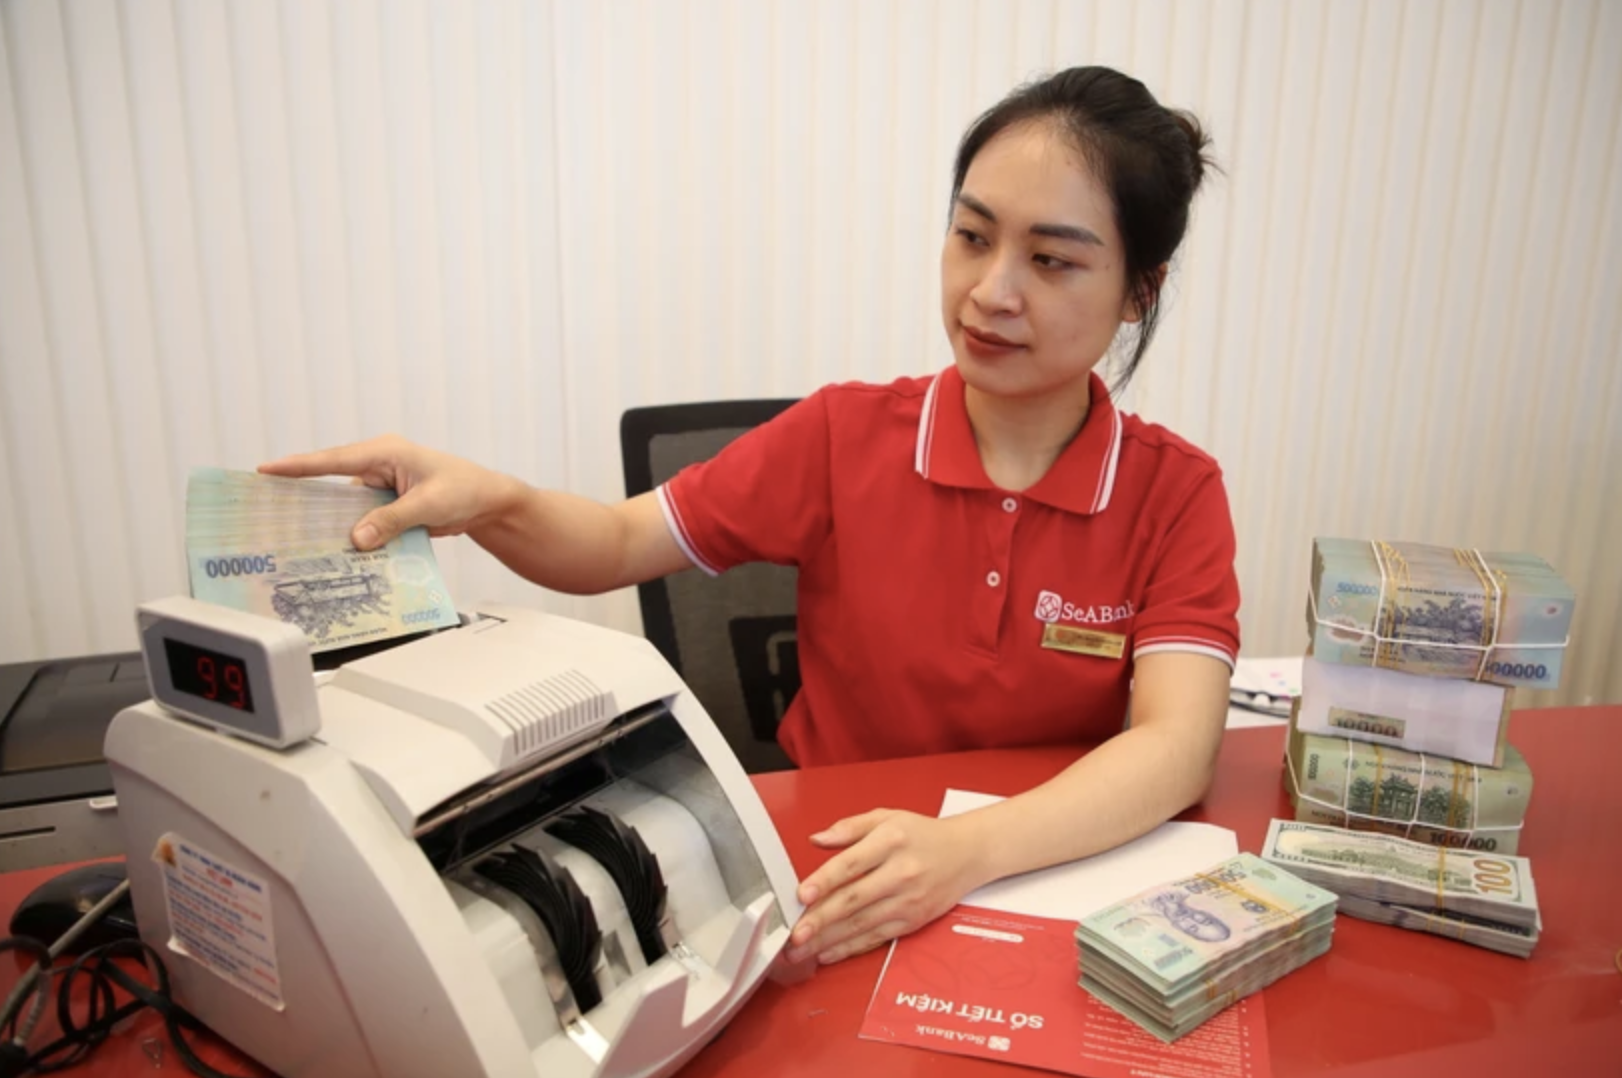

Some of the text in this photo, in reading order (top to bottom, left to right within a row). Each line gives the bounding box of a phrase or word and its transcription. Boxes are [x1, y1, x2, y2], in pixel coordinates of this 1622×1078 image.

[205, 554, 277, 578] 500000
[197, 656, 243, 710] 99
[1473, 859, 1512, 895] 100
[895, 991, 953, 1013] KIỆM
[955, 1003, 1006, 1023] TIẾT
[915, 1024, 986, 1045] SeABank
